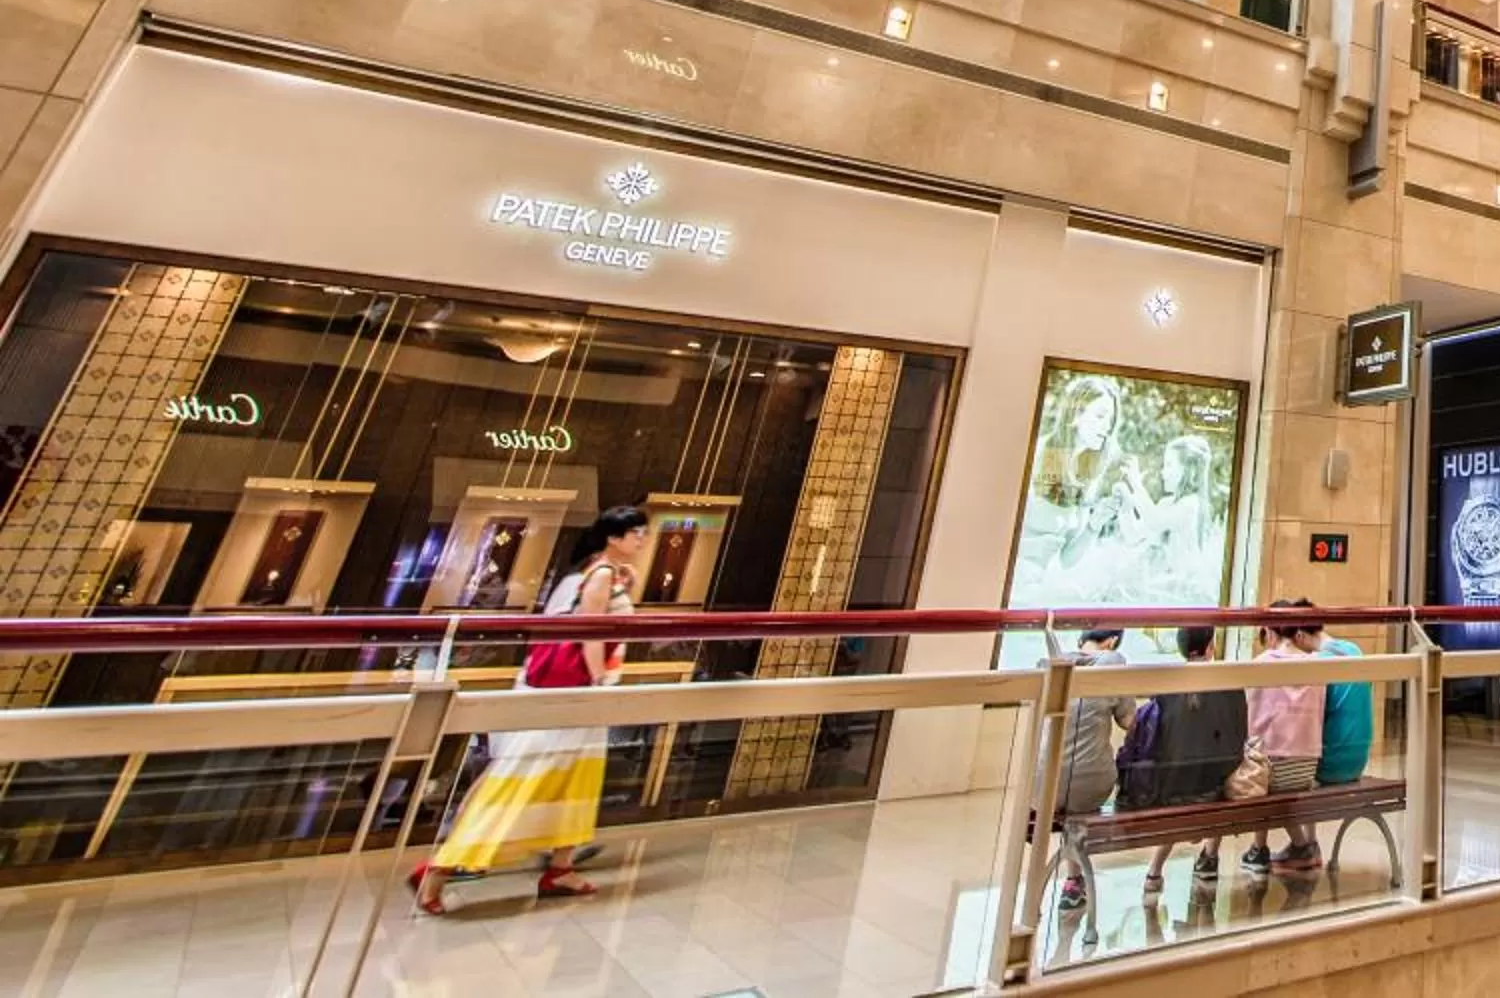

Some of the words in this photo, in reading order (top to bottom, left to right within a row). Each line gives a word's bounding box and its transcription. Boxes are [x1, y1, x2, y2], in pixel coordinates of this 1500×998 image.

[490, 192, 599, 239] PATEK
[599, 210, 733, 257] PHILIPPE
[564, 240, 652, 270] GENEVE
